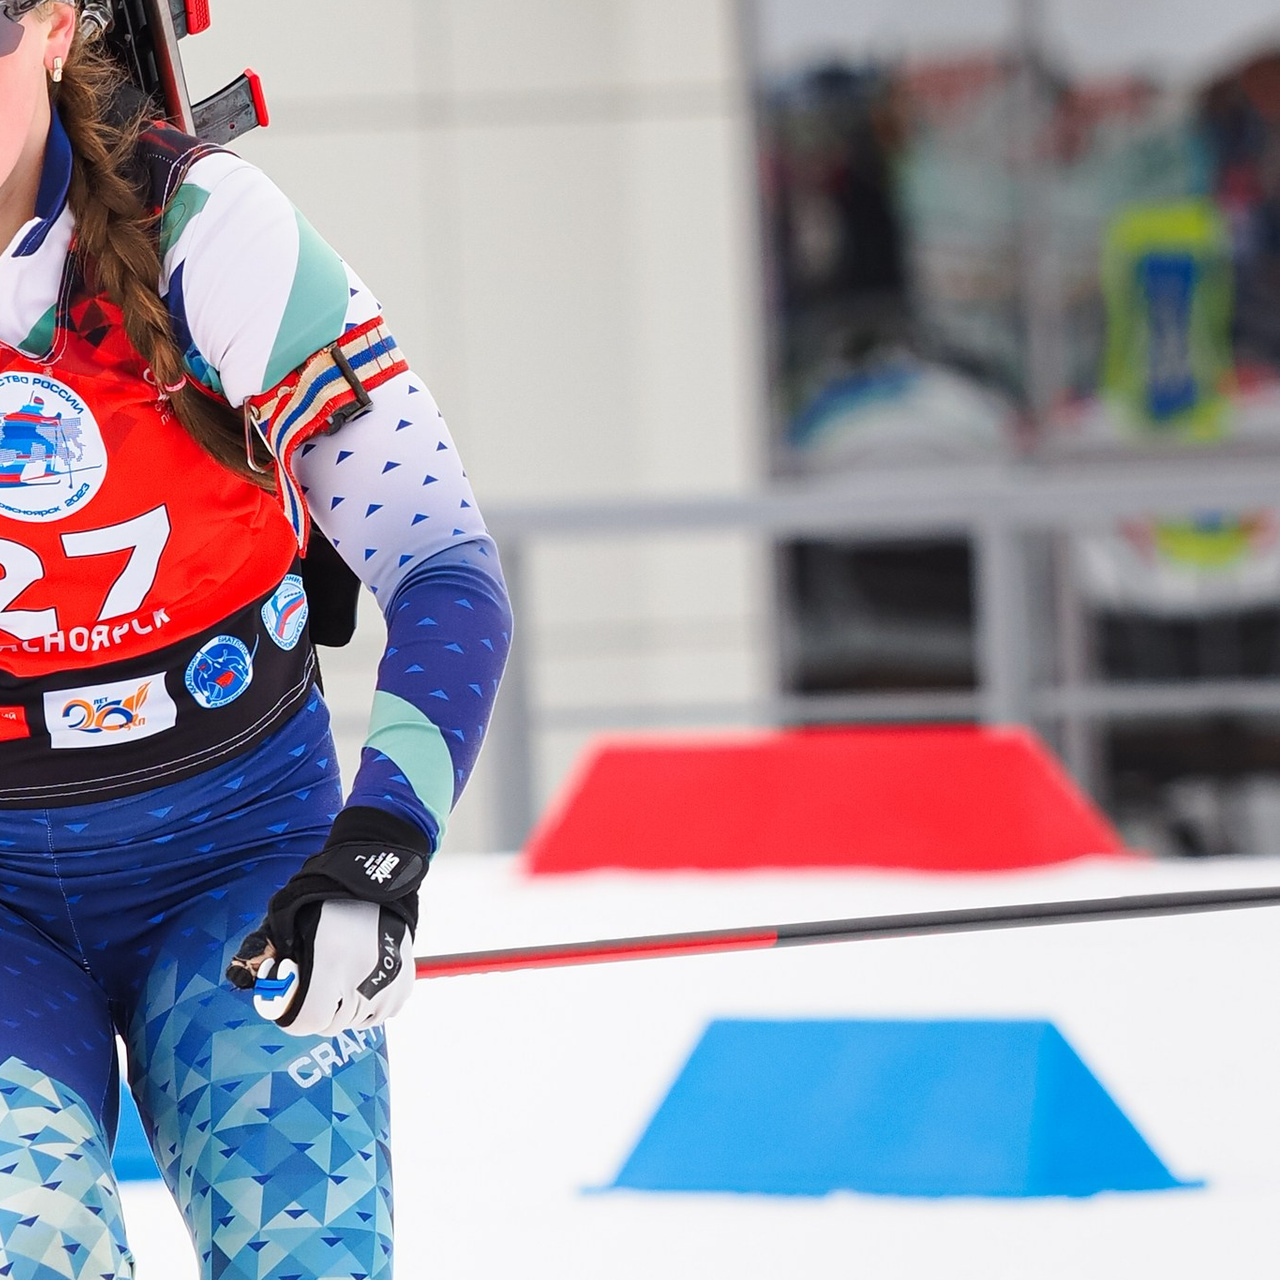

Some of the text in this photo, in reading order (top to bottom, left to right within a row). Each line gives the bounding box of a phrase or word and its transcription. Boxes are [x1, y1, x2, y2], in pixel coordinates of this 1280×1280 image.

[32, 378, 85, 415] РОССИИ
[64, 482, 91, 508] 2023
[371, 932, 395, 985] MOAX
